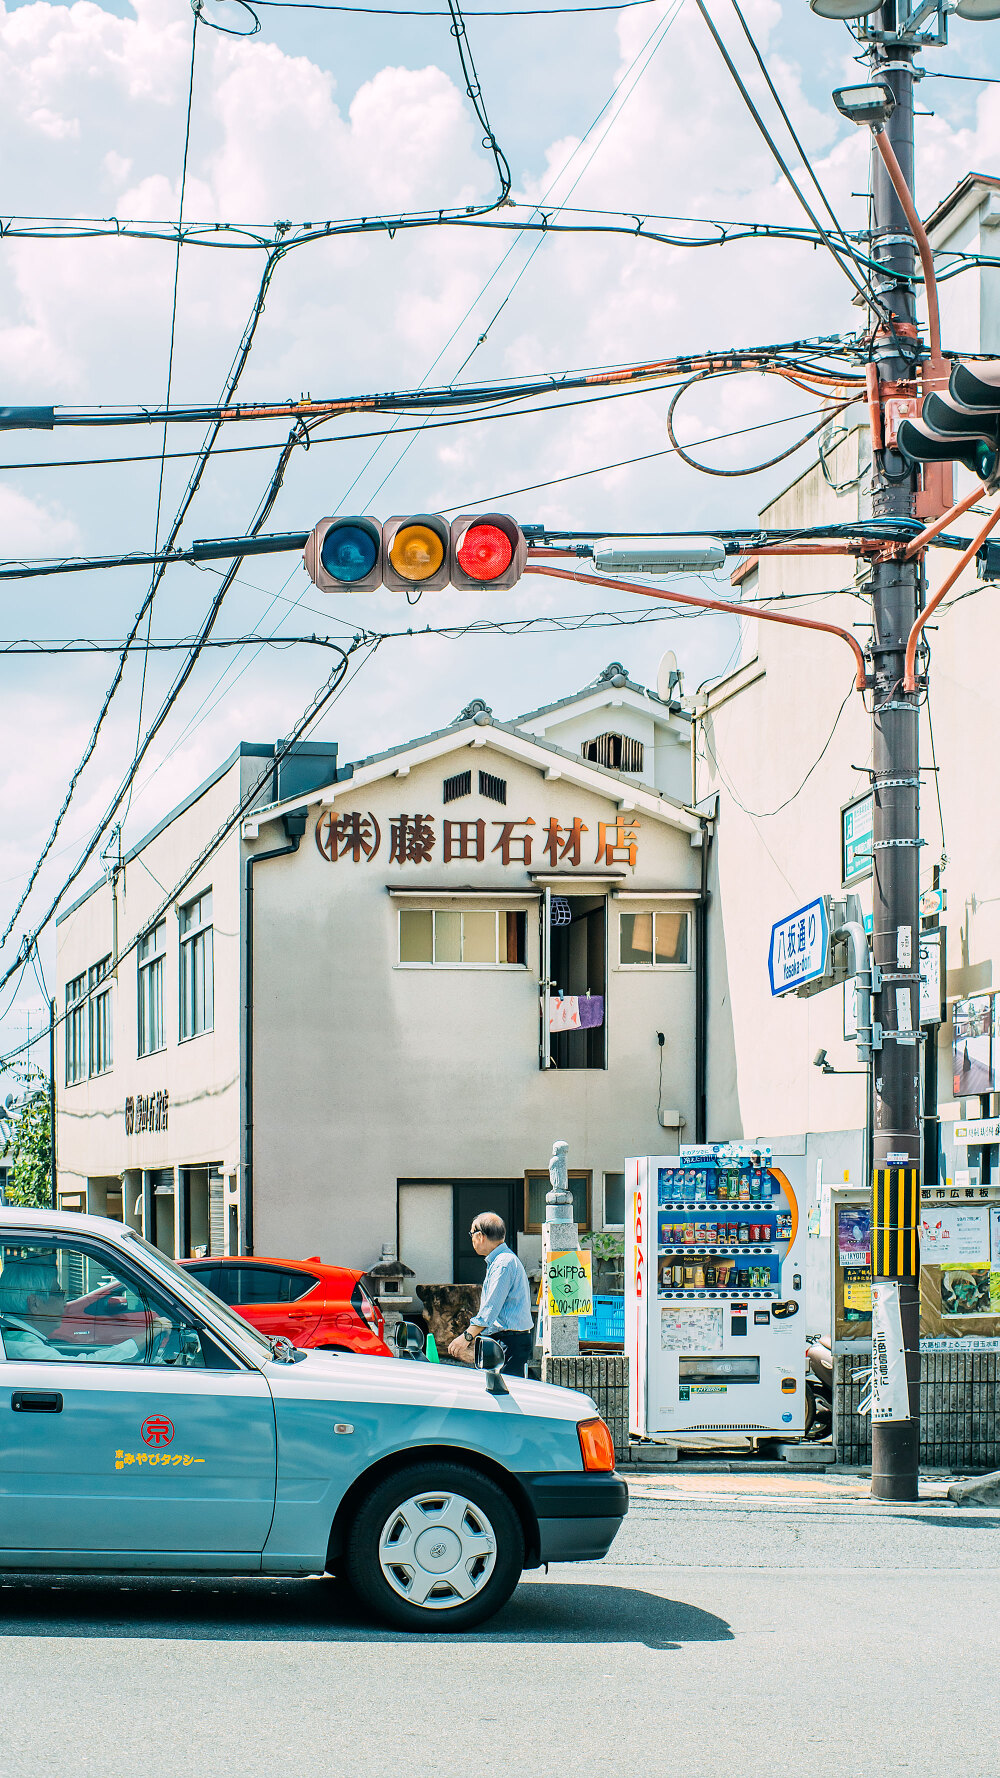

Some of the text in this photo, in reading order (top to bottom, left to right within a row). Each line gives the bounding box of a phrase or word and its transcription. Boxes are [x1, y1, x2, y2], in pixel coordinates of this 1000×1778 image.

[315, 810, 641, 867] (株)藤田石材店
[778, 913, 816, 964] 八坂通り
[783, 951, 812, 980] Yasaka-dori
[921, 1188, 989, 1199] 都市広報板
[549, 1265, 587, 1280] akippa
[877, 1331, 890, 1386] 三色信号に
[145, 1416, 171, 1444] 京
[124, 1453, 206, 1466] みやびタクシー
